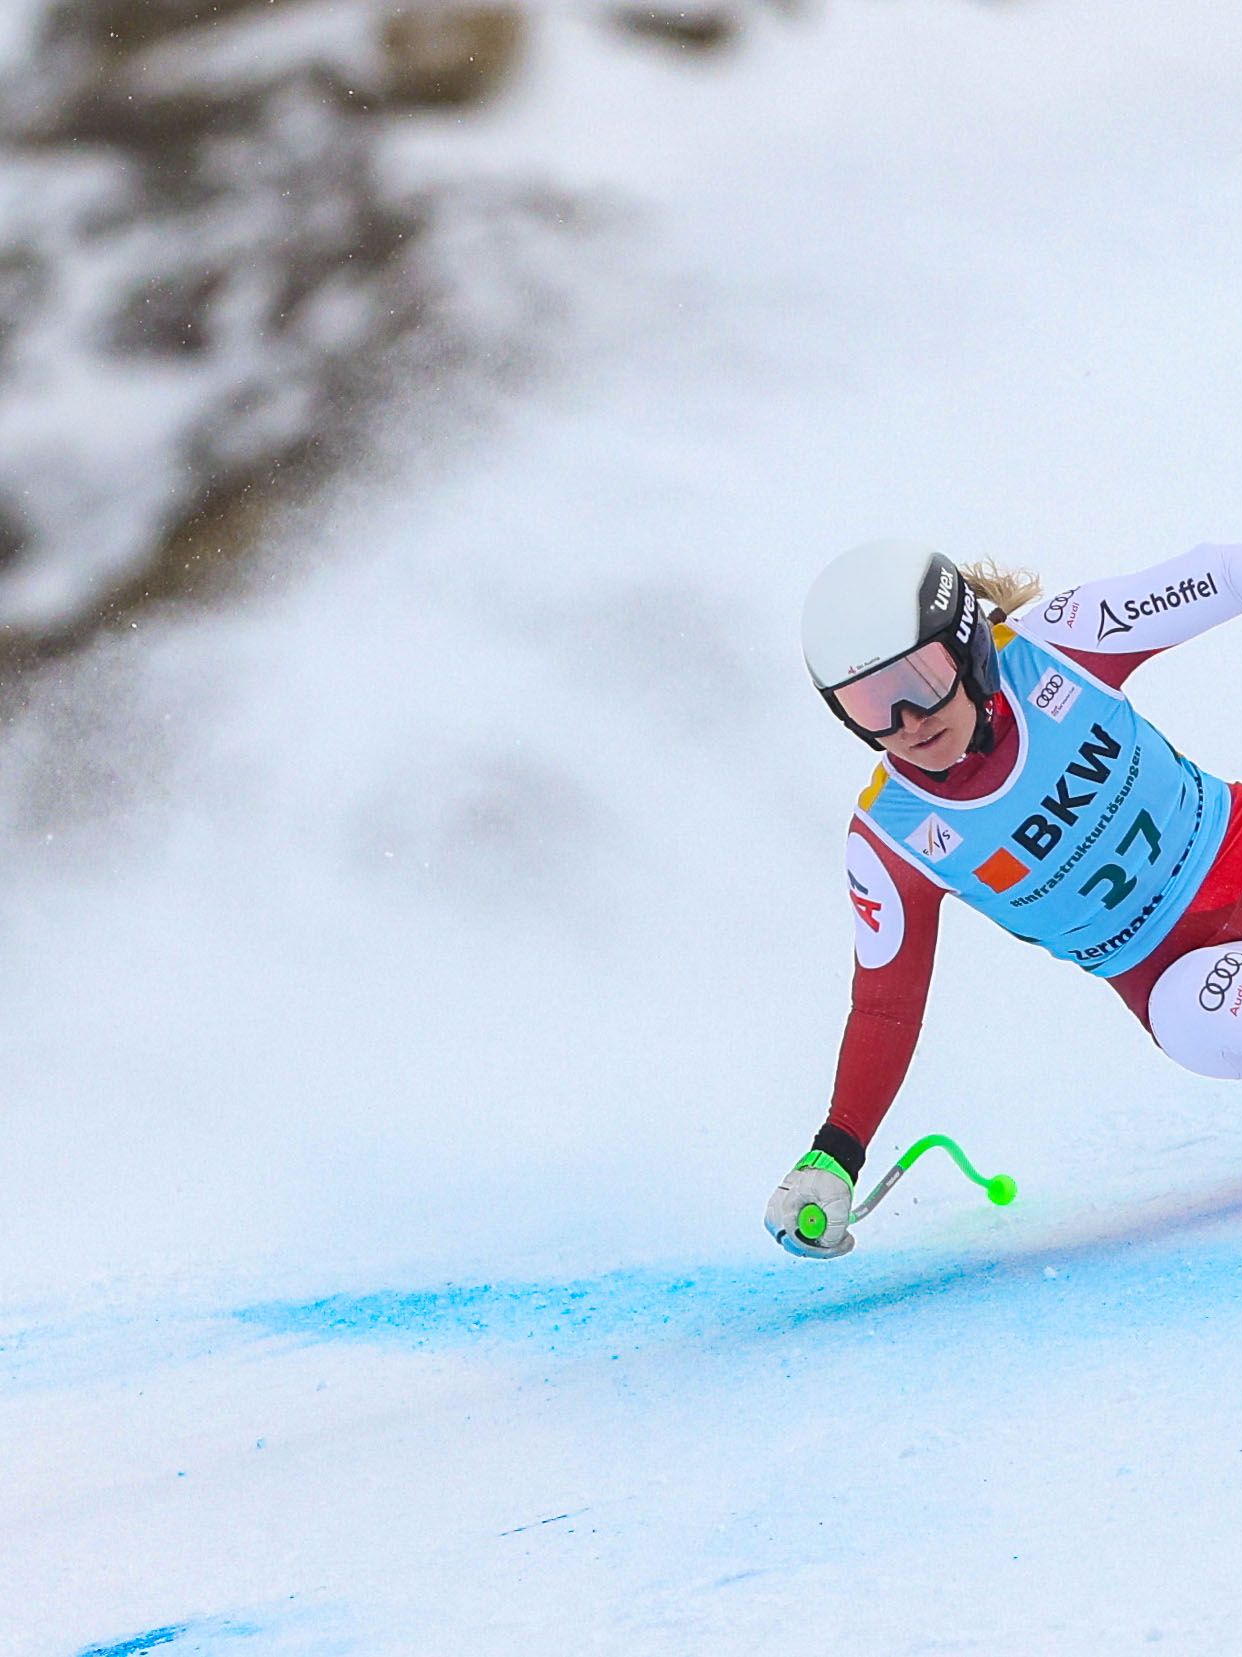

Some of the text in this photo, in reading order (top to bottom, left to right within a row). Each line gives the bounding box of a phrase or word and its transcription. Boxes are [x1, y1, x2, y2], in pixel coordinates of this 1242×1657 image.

[934, 566, 954, 611] uvex
[956, 582, 975, 644] uvex
[1066, 602, 1080, 629] Audi
[1124, 572, 1218, 621] Schöffel
[1011, 723, 1122, 861] BKW
[922, 829, 951, 856] FIS
[1078, 808, 1162, 910] 27
[847, 869, 882, 933] A1
